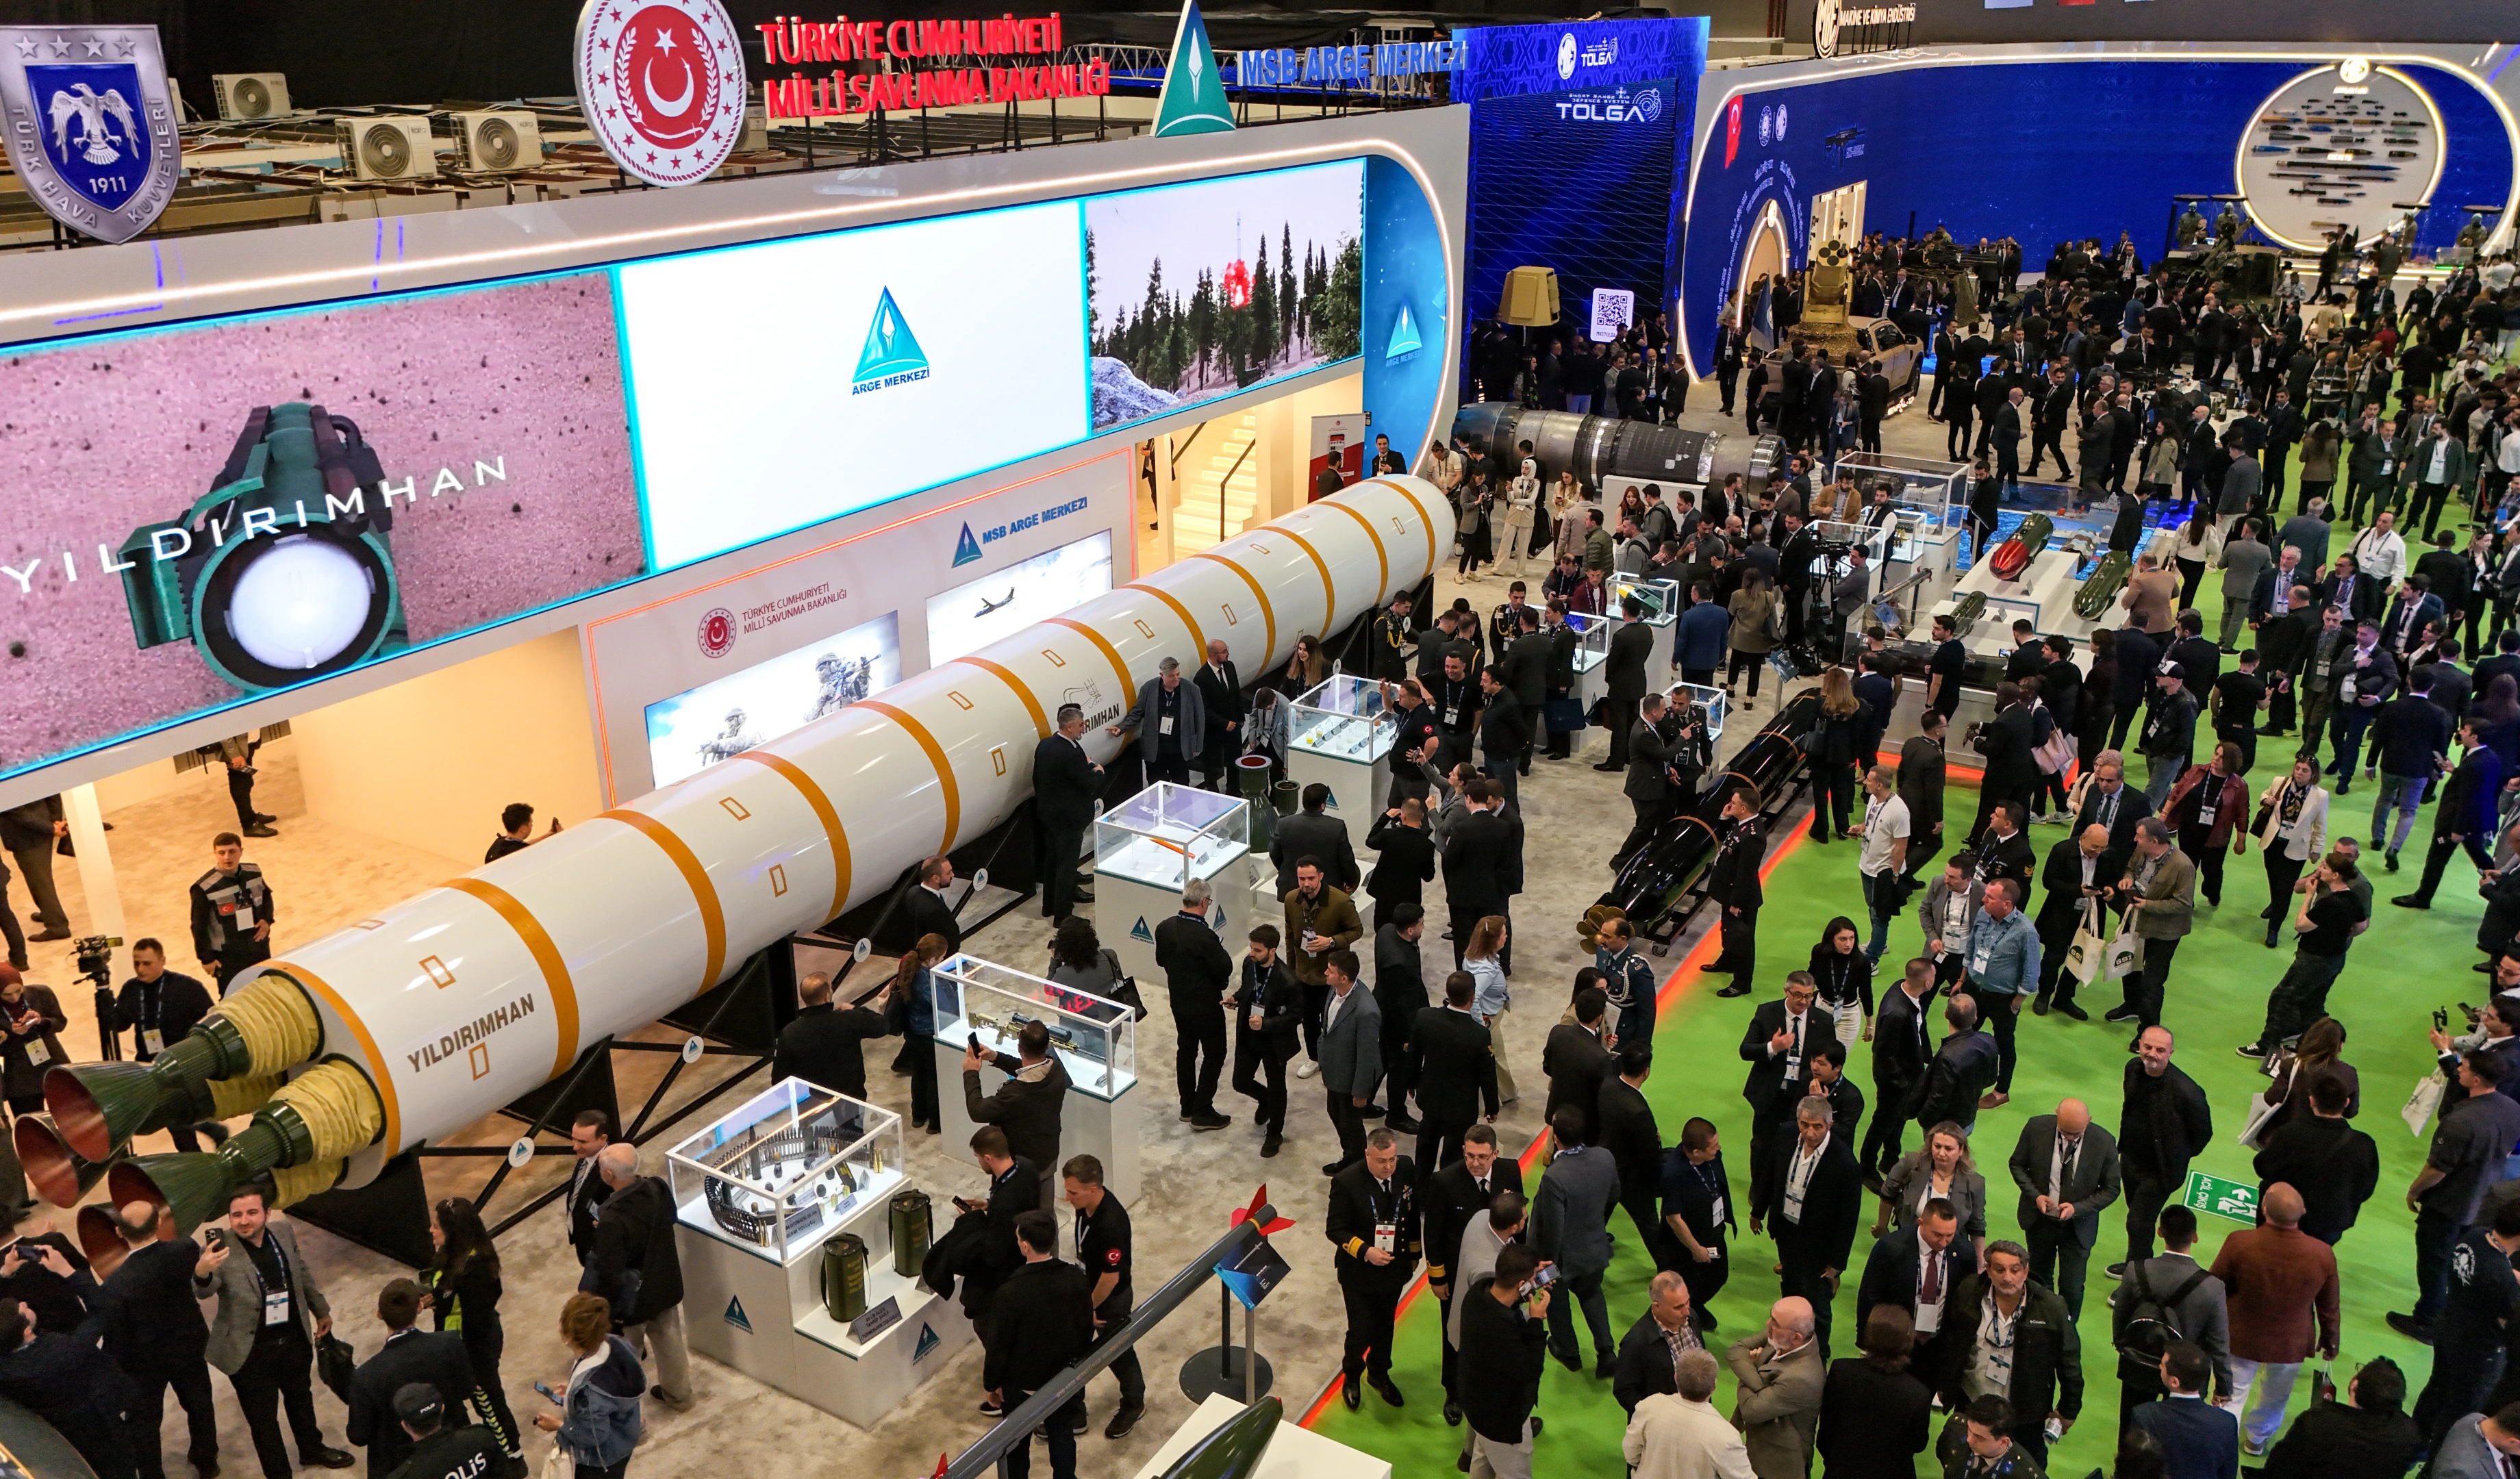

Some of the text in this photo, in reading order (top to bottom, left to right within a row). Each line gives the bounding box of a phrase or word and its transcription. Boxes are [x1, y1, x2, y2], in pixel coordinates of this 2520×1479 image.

[1840, 6, 1862, 26] MAKİNE
[1863, 9, 1870, 25] VE
[1870, 5, 1887, 24] KİMYA
[756, 12, 1061, 65] TÜRKİYE CUMHURİYETİ
[1237, 49, 1298, 86] MSB
[1302, 45, 1370, 81] ARGE
[1581, 52, 1612, 67] TOLGA
[764, 56, 1109, 119] MİLLÎ SAVUNMA BAKANLIĞI
[1556, 103, 1645, 123] TOLGA
[12, 98, 173, 229] TÜRK HAVA KUVVETLERİ
[88, 176, 127, 194] 1911
[852, 366, 930, 396] ARGE MERKEZİ
[0, 455, 507, 594] YILDIRIMHAN
[982, 525, 1007, 544] MSB
[1009, 514, 1040, 535] ARGE
[742, 581, 829, 622] TÜRKİYE CUMHURİYETİ
[744, 588, 847, 635] MİLLÎ SAVUNMA BAKANLIĞI
[1083, 703, 1120, 735] RIMHAN
[406, 993, 535, 1074] YILDIRIMHAN
[2193, 1176, 2213, 1209] ACİL ÇIKIŞ
